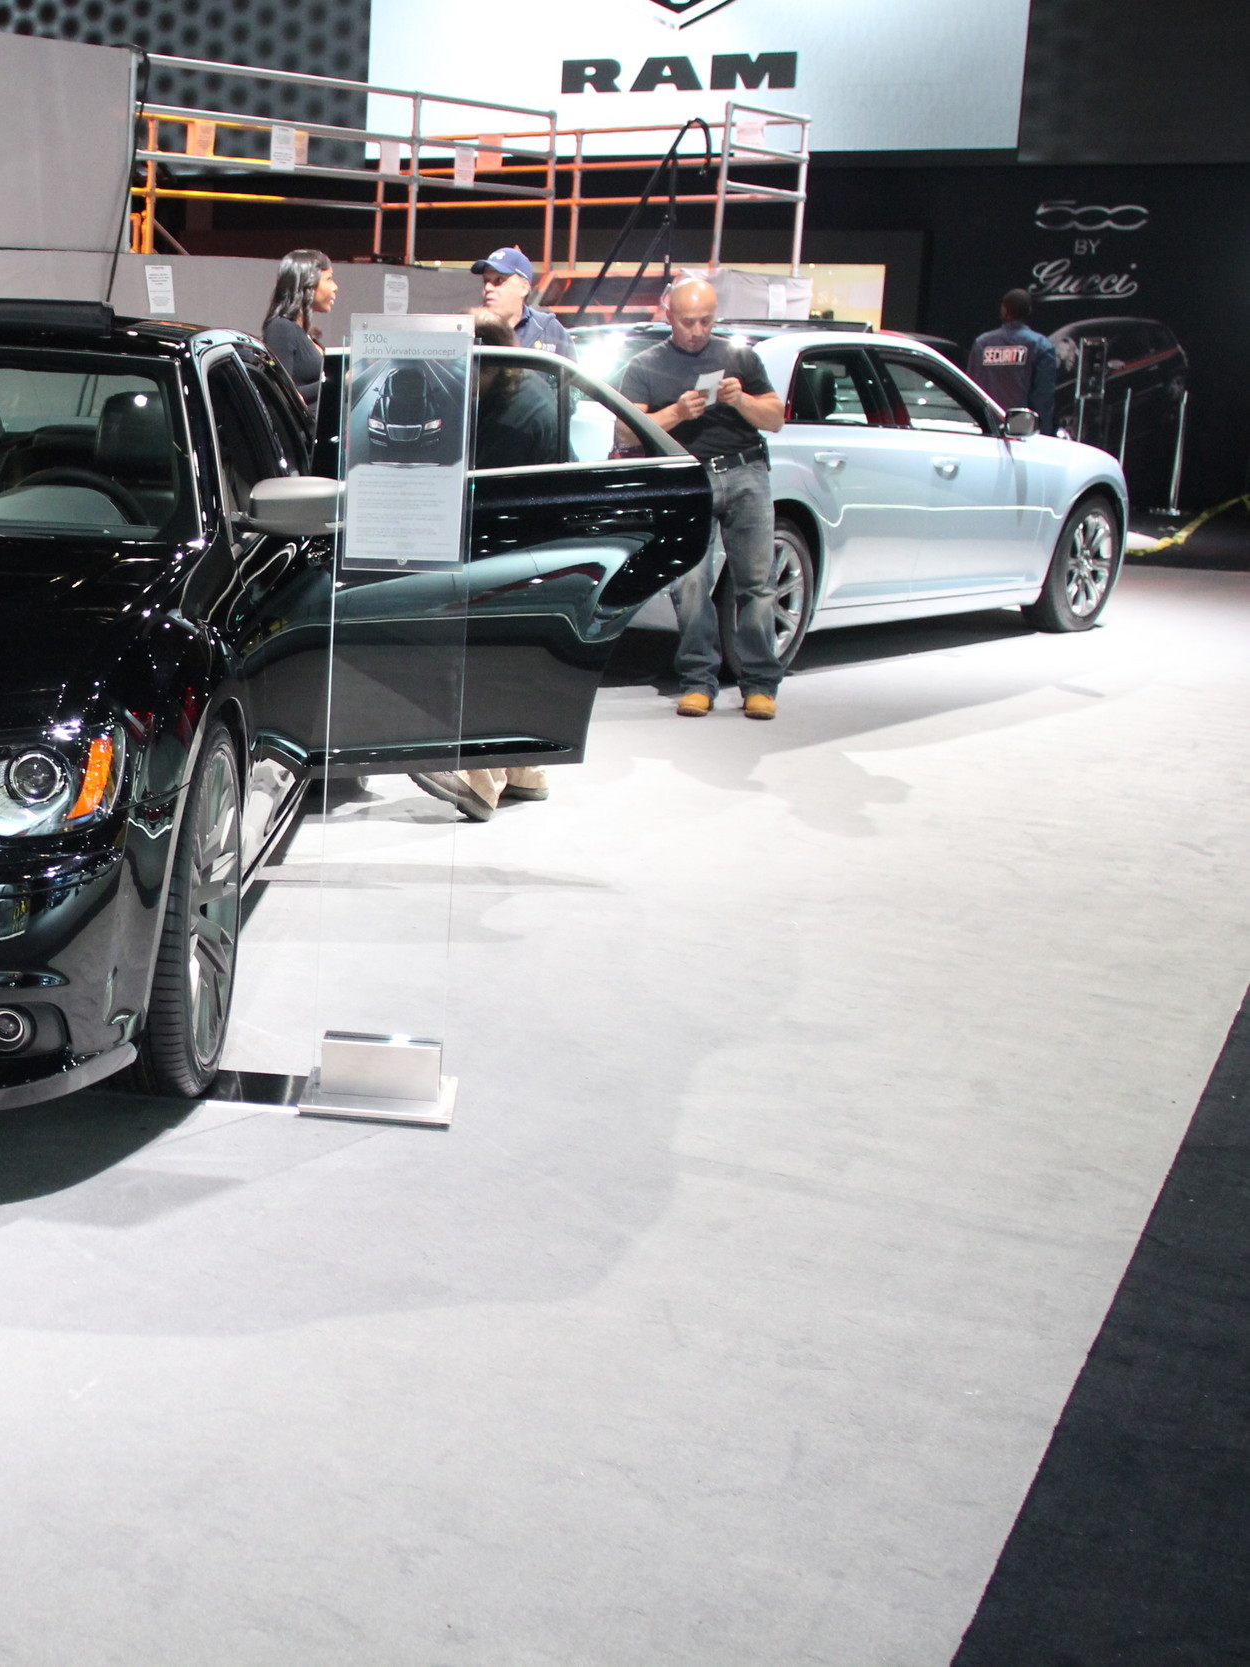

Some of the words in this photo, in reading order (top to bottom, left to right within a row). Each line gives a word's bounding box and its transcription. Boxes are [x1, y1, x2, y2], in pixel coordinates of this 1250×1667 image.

[561, 51, 798, 94] RAM
[1035, 200, 1149, 231] 500
[1074, 239, 1100, 254] BY
[1028, 258, 1138, 302] Gucci
[362, 345, 383, 355] John
[385, 346, 420, 355] Varvatos
[423, 347, 456, 357] concept
[984, 348, 1025, 363] SECURITY
